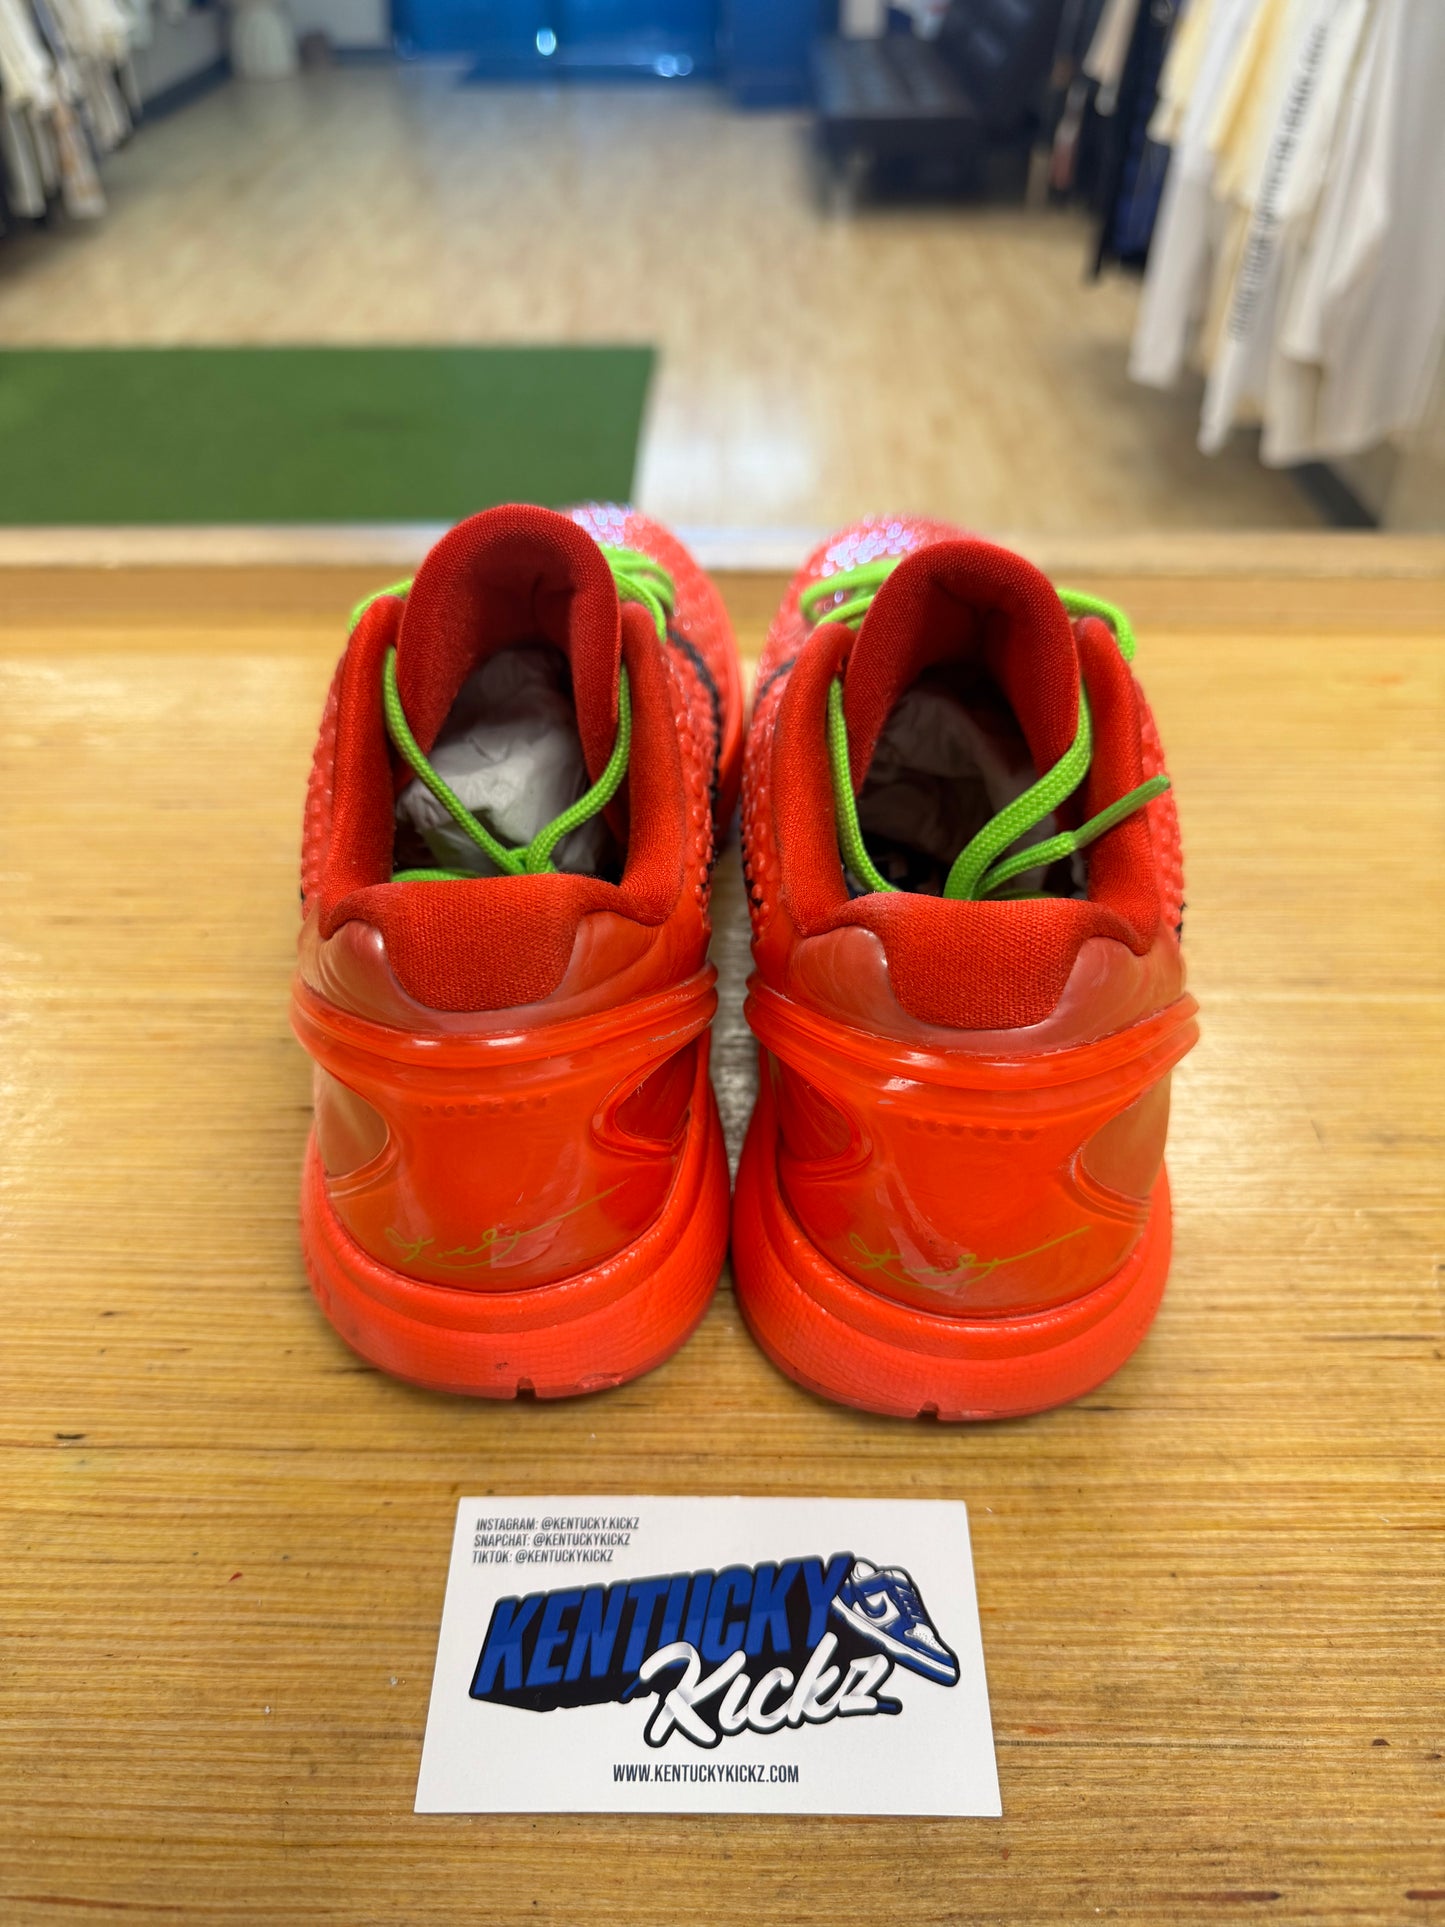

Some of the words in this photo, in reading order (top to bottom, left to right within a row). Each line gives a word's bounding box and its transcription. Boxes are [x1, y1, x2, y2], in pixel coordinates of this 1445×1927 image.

[476, 1517, 538, 1531] INSTAGRAM:
[541, 1516, 640, 1531] @KENTUCKY.KICKZ
[474, 1533, 531, 1547] SNAPCHAT:
[533, 1532, 631, 1547] @KENTUCKYKICKZ
[472, 1550, 513, 1564] TIKTOK:
[515, 1549, 614, 1564] @KENTUCKYKICKZ
[473, 1553, 854, 1695] KENTUCKY
[638, 1631, 889, 1743] Kickz
[613, 1763, 800, 1783] WWW.KENTUCKYKICKZ.COM
